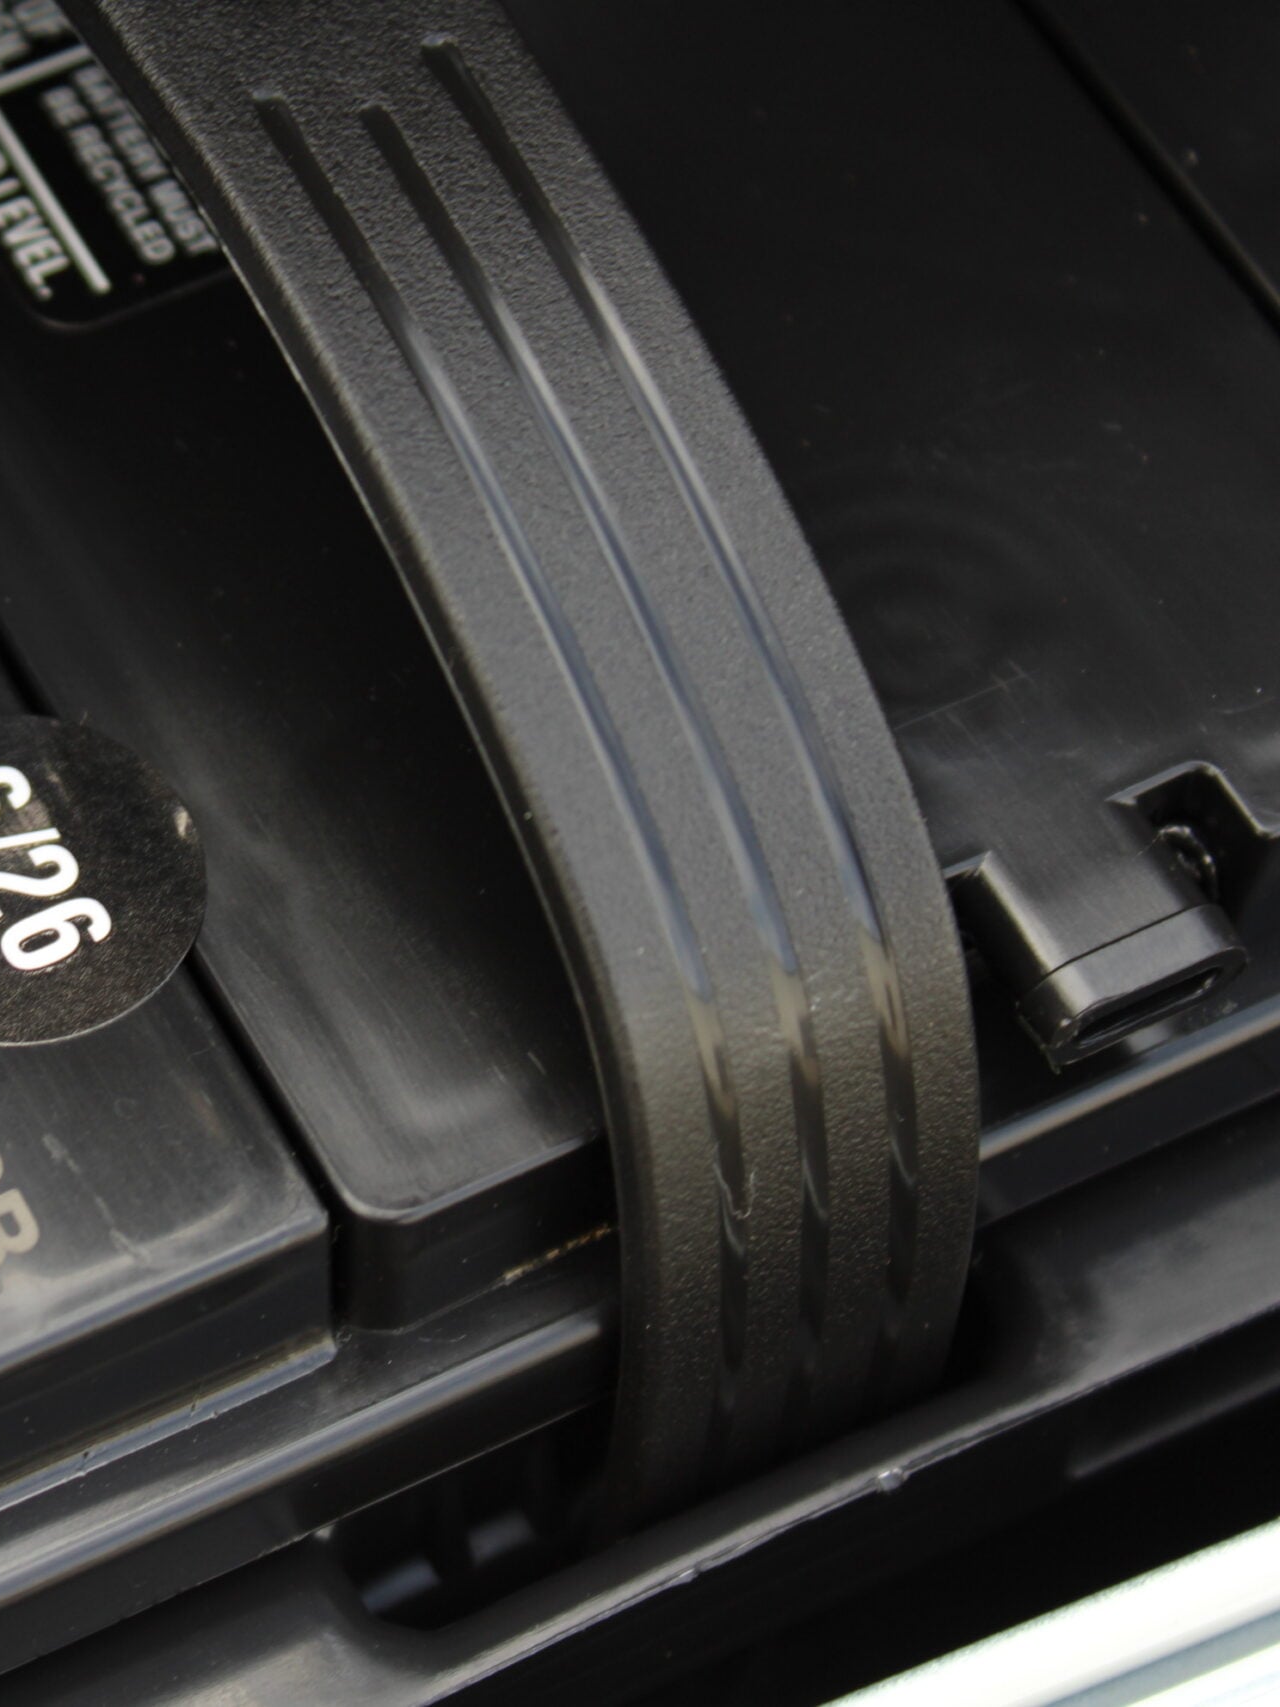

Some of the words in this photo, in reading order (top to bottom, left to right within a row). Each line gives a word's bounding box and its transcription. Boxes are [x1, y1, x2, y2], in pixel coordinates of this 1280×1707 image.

[42, 85, 90, 127] BE
[70, 124, 176, 265] RECYCLED
[150, 178, 218, 255] MUST
